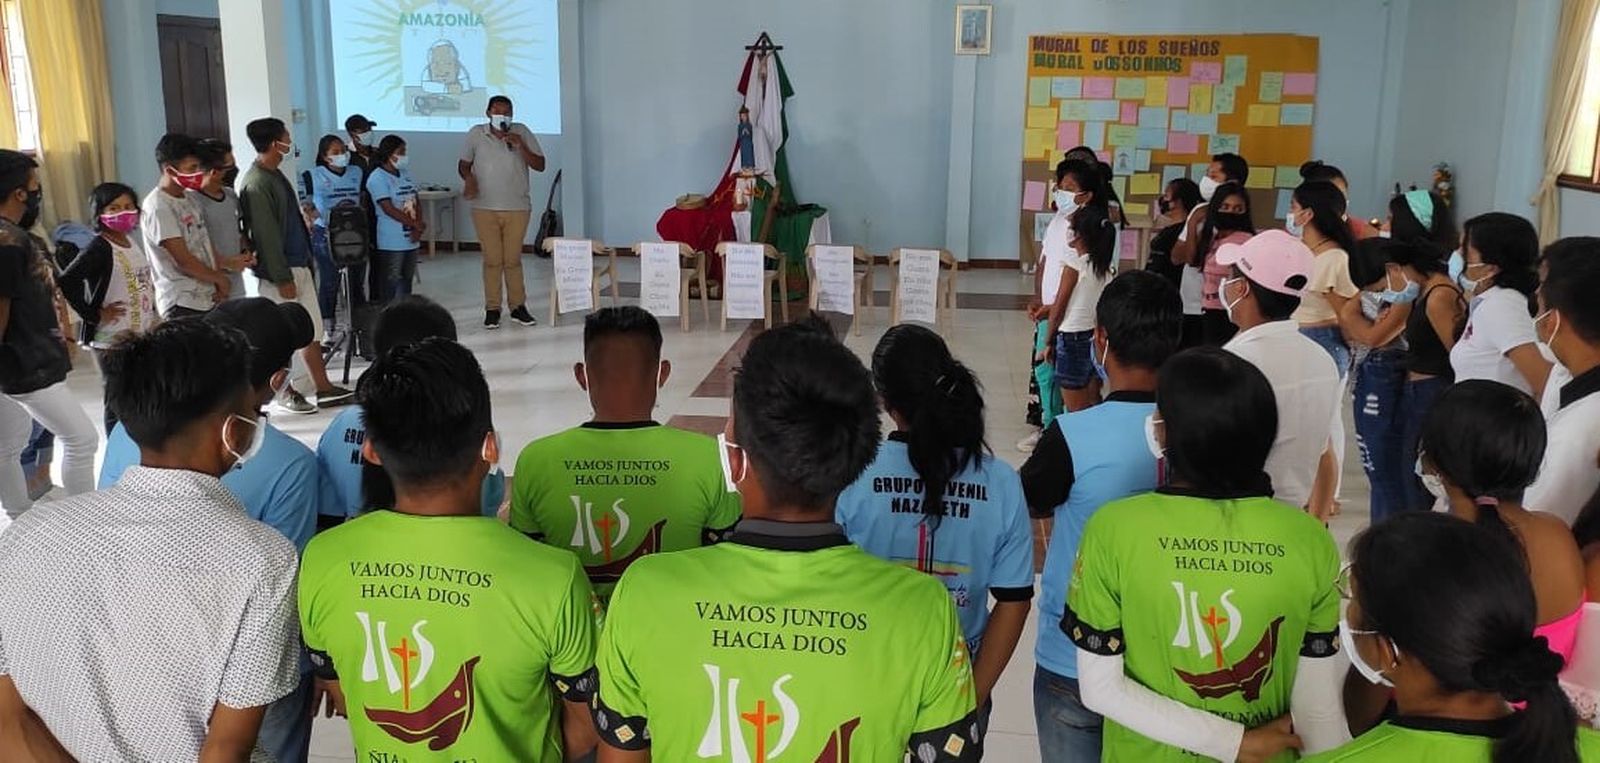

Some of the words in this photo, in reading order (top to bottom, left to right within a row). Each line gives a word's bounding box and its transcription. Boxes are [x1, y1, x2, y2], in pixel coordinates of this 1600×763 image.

[1033, 36, 1081, 53] MURAL
[1091, 39, 1109, 53] DE
[1118, 39, 1148, 55] LOS
[1034, 53, 1084, 70] MURAL
[345, 428, 365, 445] GRU
[564, 460, 613, 471] VAMOS
[616, 460, 670, 472] JUNTOS
[575, 475, 619, 486] HACIA
[624, 475, 657, 486] DIOS
[873, 477, 925, 494] GRUPO
[891, 498, 971, 519] NAZETH
[1158, 537, 1219, 552] VAMOS
[1223, 540, 1286, 558] JUNTOS
[350, 561, 415, 578] VAMOS
[419, 565, 492, 588] JUNTOS
[1175, 556, 1228, 572] HACIA
[1232, 559, 1274, 576] DIOS
[361, 584, 421, 600] HACIA
[427, 588, 471, 608] DIOS
[695, 602, 776, 623] VAMOS
[781, 608, 868, 631] JUNTOS
[712, 630, 787, 650] HACIA
[793, 635, 848, 656] DIOS
